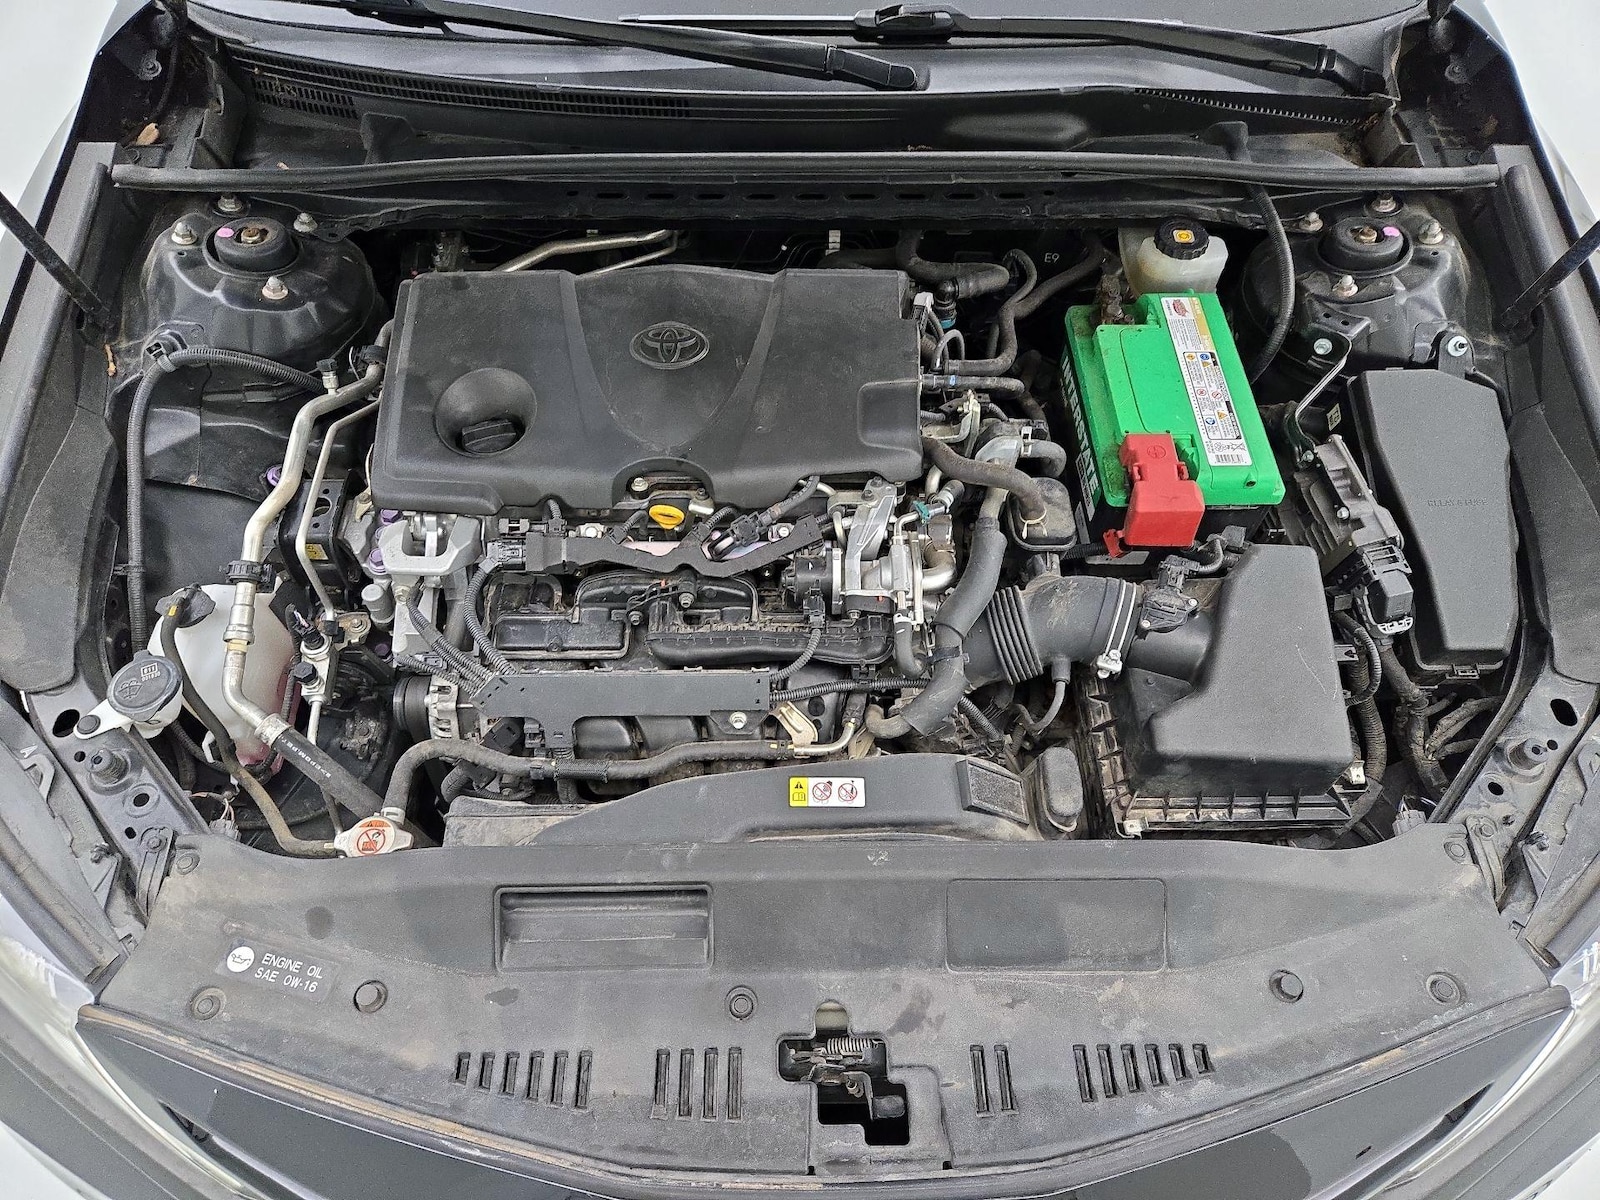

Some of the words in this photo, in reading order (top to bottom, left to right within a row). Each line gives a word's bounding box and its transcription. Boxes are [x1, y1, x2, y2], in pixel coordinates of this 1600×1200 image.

[1044, 252, 1060, 263] E9
[1062, 356, 1099, 495] INTERSTATE
[261, 952, 304, 974] ENGINE
[306, 965, 323, 979] OIL
[254, 967, 280, 983] SAE
[283, 974, 319, 993] 0W-16
